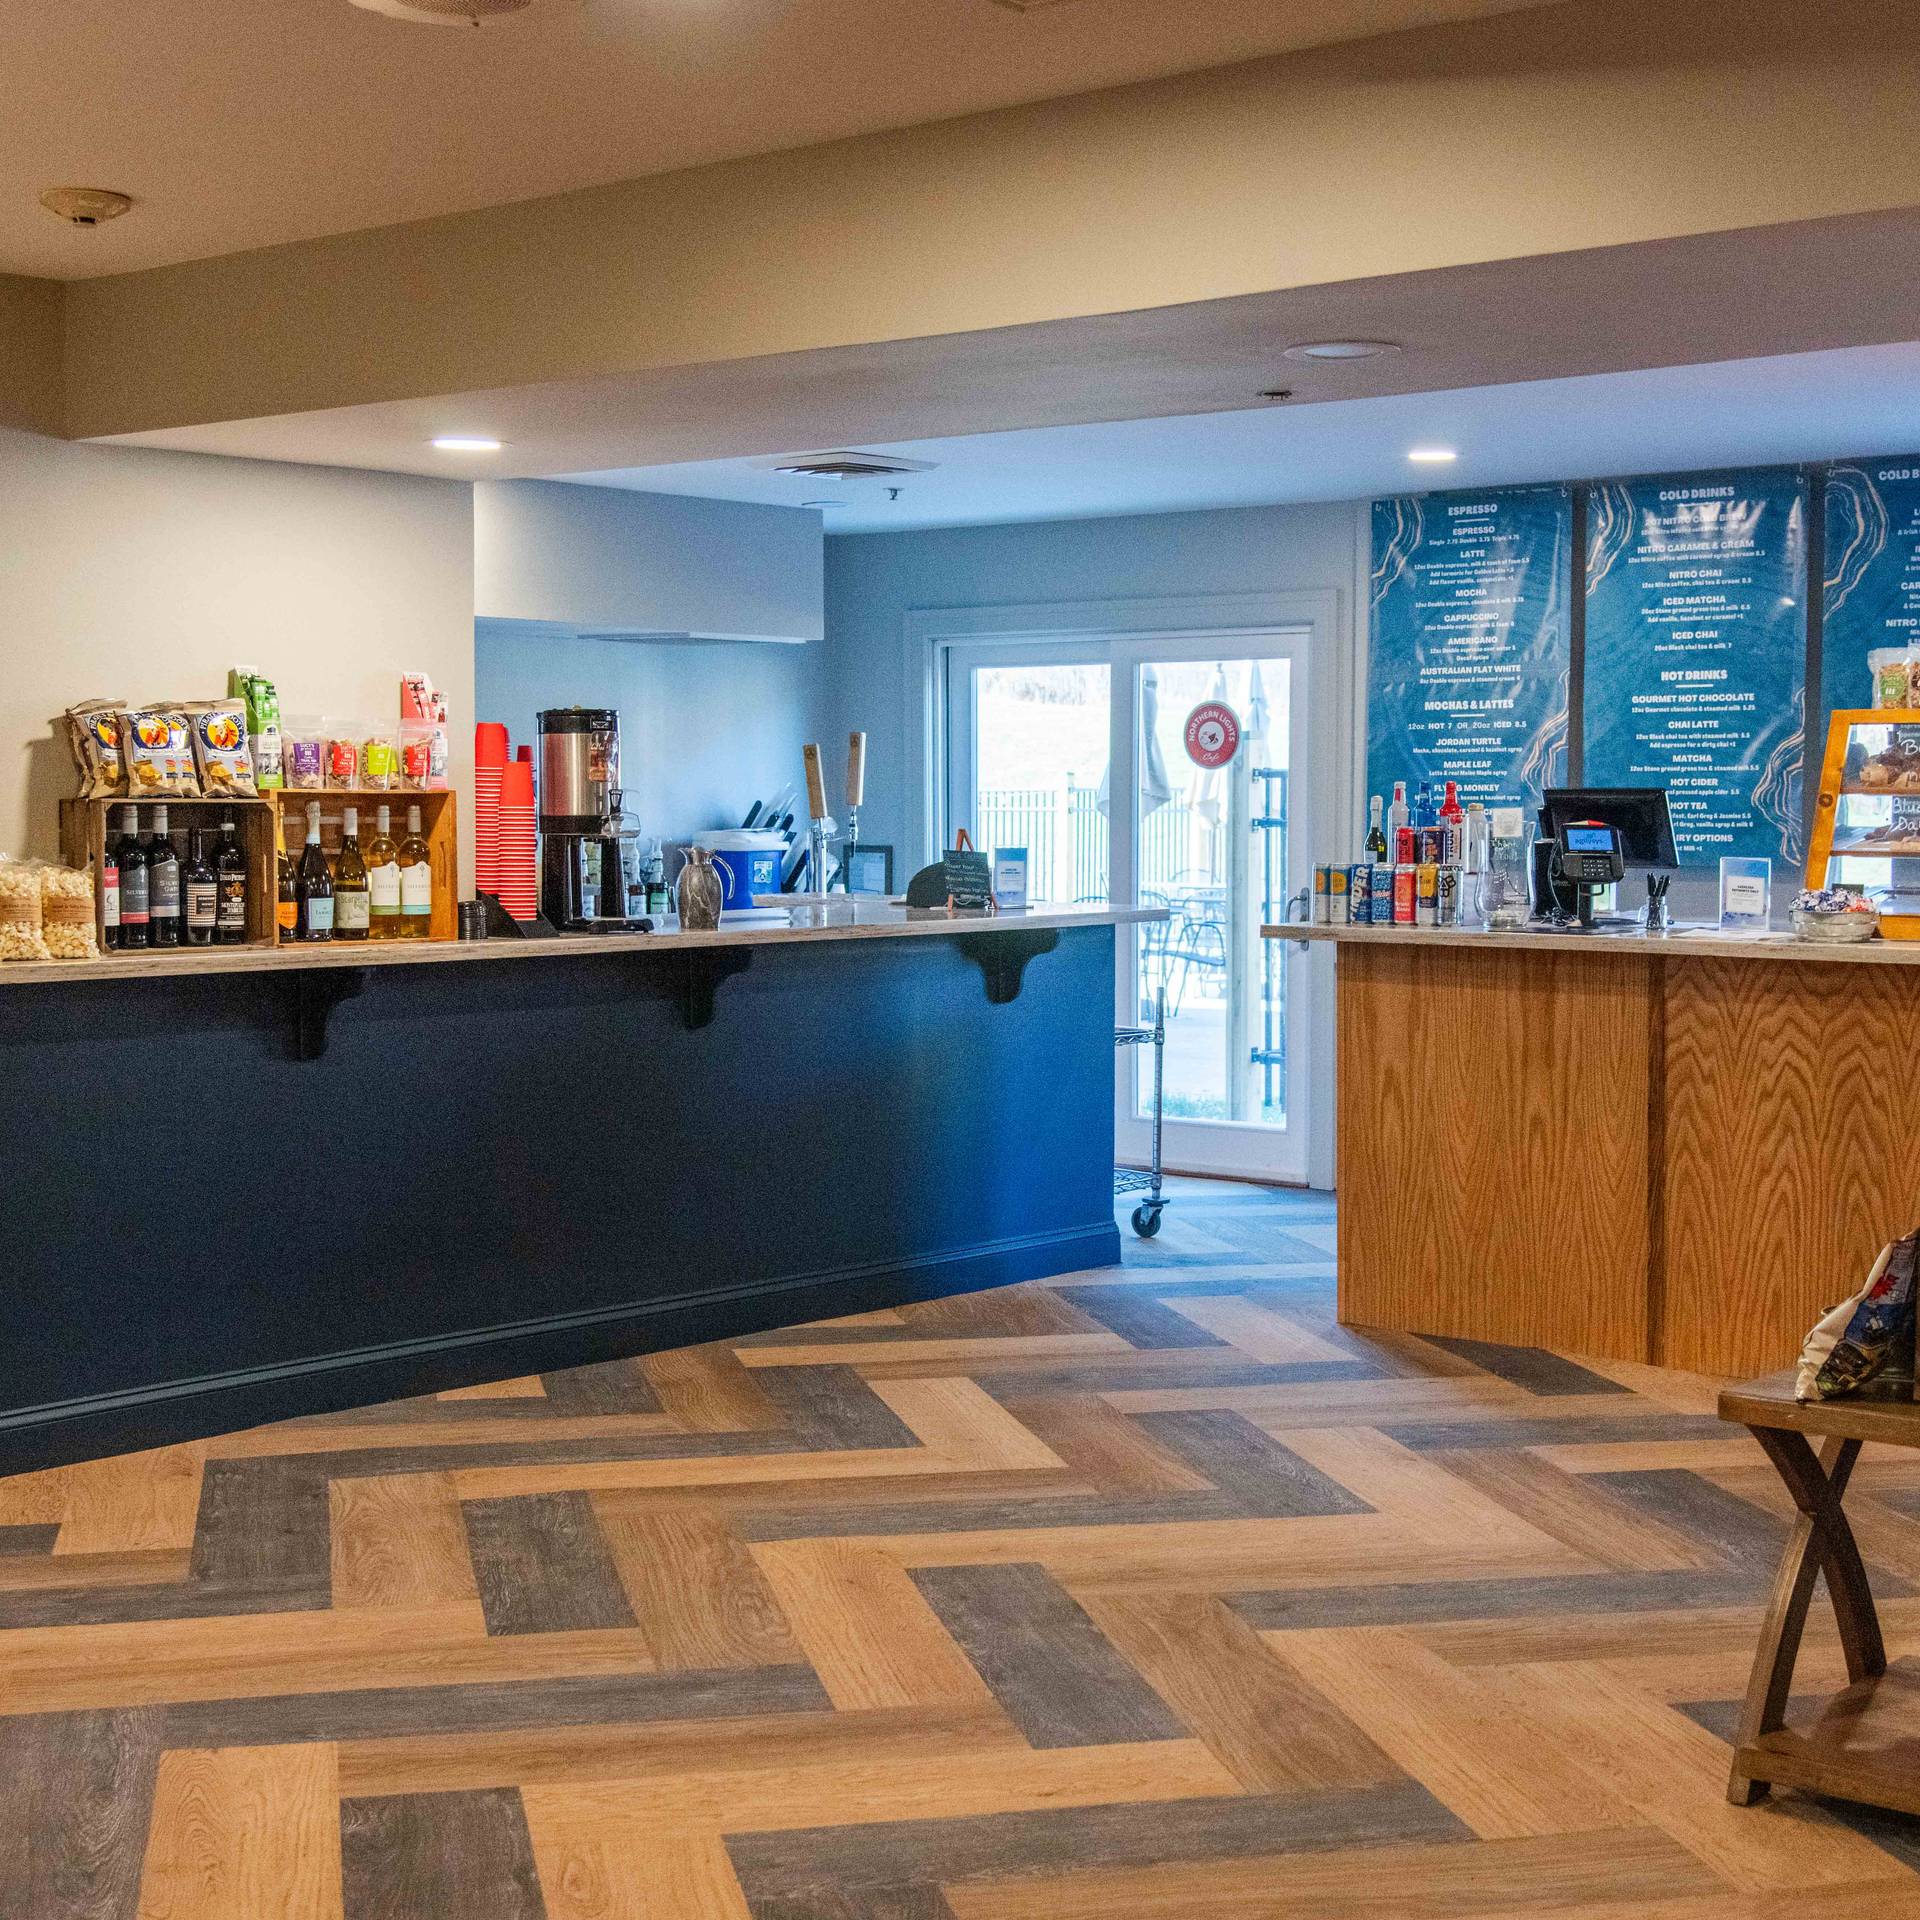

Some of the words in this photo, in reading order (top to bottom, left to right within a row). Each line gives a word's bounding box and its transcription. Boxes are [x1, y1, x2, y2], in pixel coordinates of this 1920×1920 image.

[1878, 469, 1910, 481] COLD
[1659, 490, 1690, 501] COLD
[1691, 486, 1735, 499] DRINKS
[1448, 503, 1498, 516] ESPRESSO
[1663, 515, 1691, 525] NITRO
[1452, 526, 1495, 536] ESPRESSO
[1638, 545, 1665, 554] NITRO
[1667, 542, 1710, 553] CARAMEL
[1720, 539, 1754, 549] CREAM
[1460, 549, 1485, 559] LATTE
[1669, 570, 1698, 579] NITRO
[1699, 569, 1722, 578] CHAI
[1455, 588, 1488, 597] MOCHA
[1663, 597, 1684, 606] ICED
[1686, 595, 1726, 605] MATCHA
[1444, 612, 1499, 623] CAPPUCCINO
[1886, 619, 1918, 627] NITRO
[1672, 632, 1694, 640] ICED
[1695, 630, 1718, 639] CHAI
[1448, 636, 1498, 645] AMERICANO
[1420, 666, 1473, 676] AUSTRALIAN
[1473, 666, 1493, 674] FLAT
[1493, 664, 1521, 673] WHITE
[1661, 671, 1685, 681] HOT
[1685, 669, 1728, 680] DRINKS
[1632, 695, 1677, 704] GOURMET
[1678, 694, 1698, 702] HOT
[1698, 693, 1755, 702] CHOCOLATE
[1424, 700, 1469, 711] MOCHAS
[1469, 700, 1478, 710] &
[1479, 698, 1514, 709] LATTES
[1188, 710, 1218, 742] NORTHERN
[1220, 714, 1236, 742] LIGHTS
[1493, 720, 1512, 728] ICED
[1668, 721, 1691, 729] CHAI
[1692, 720, 1719, 728] LATTE
[1436, 738, 1471, 746] JORDAN
[1672, 754, 1712, 763] MATCHA
[1444, 761, 1472, 769] MAPLE
[1473, 760, 1492, 768] LEAF
[1670, 778, 1690, 787] HOT
[1464, 784, 1500, 792] MONKEY
[1670, 802, 1690, 810] HOT
[1691, 802, 1708, 810] TEA
